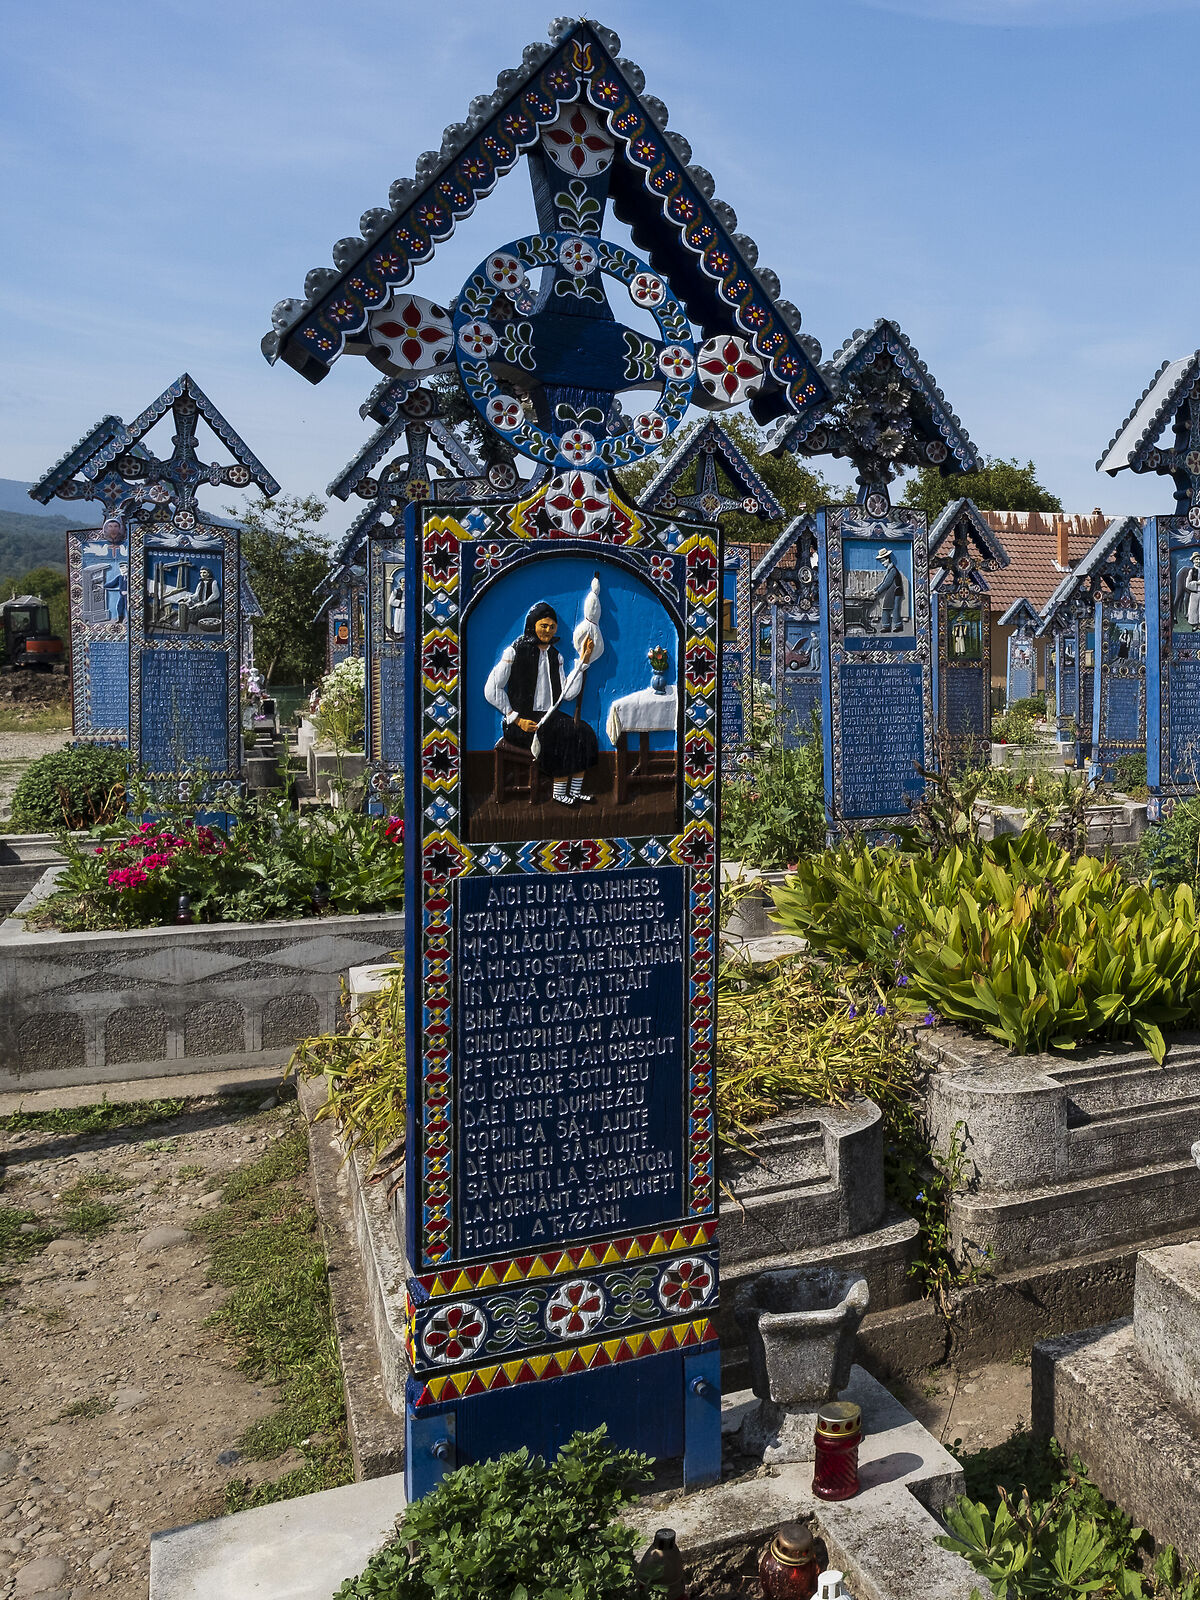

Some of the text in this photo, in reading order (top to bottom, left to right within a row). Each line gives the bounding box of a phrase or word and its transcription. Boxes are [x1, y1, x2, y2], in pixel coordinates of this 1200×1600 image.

[487, 886, 521, 907] AICI
[526, 884, 547, 904] EU
[464, 910, 508, 932] STAN
[602, 901, 665, 923] NUMESC
[464, 936, 498, 957] MI-O
[568, 930, 580, 951] A
[583, 926, 641, 948] TOARCE
[487, 959, 521, 979] MI-O
[524, 955, 565, 976] FOST
[577, 975, 601, 995] AM
[464, 1007, 503, 1031] BINE
[507, 1004, 533, 1026] AM
[464, 1017, 652, 1054] CINCI COPII EU AM AVUT
[464, 1059, 483, 1080] PE
[529, 1050, 568, 1071] BINE
[608, 1036, 675, 1061] CRESCUT
[463, 1082, 486, 1102] CU
[491, 1074, 564, 1100] GRIGORE
[617, 1062, 649, 1084] MEU
[515, 1098, 553, 1121] BINE
[558, 1085, 645, 1116] DUMNEZEU
[523, 1122, 546, 1143] CA
[601, 1108, 649, 1133] AJUTE
[492, 1149, 534, 1172] MINE
[539, 1146, 554, 1166] EI
[557, 1166, 580, 1187] LA
[531, 1218, 546, 1237] A
[568, 1212, 590, 1231] 76
